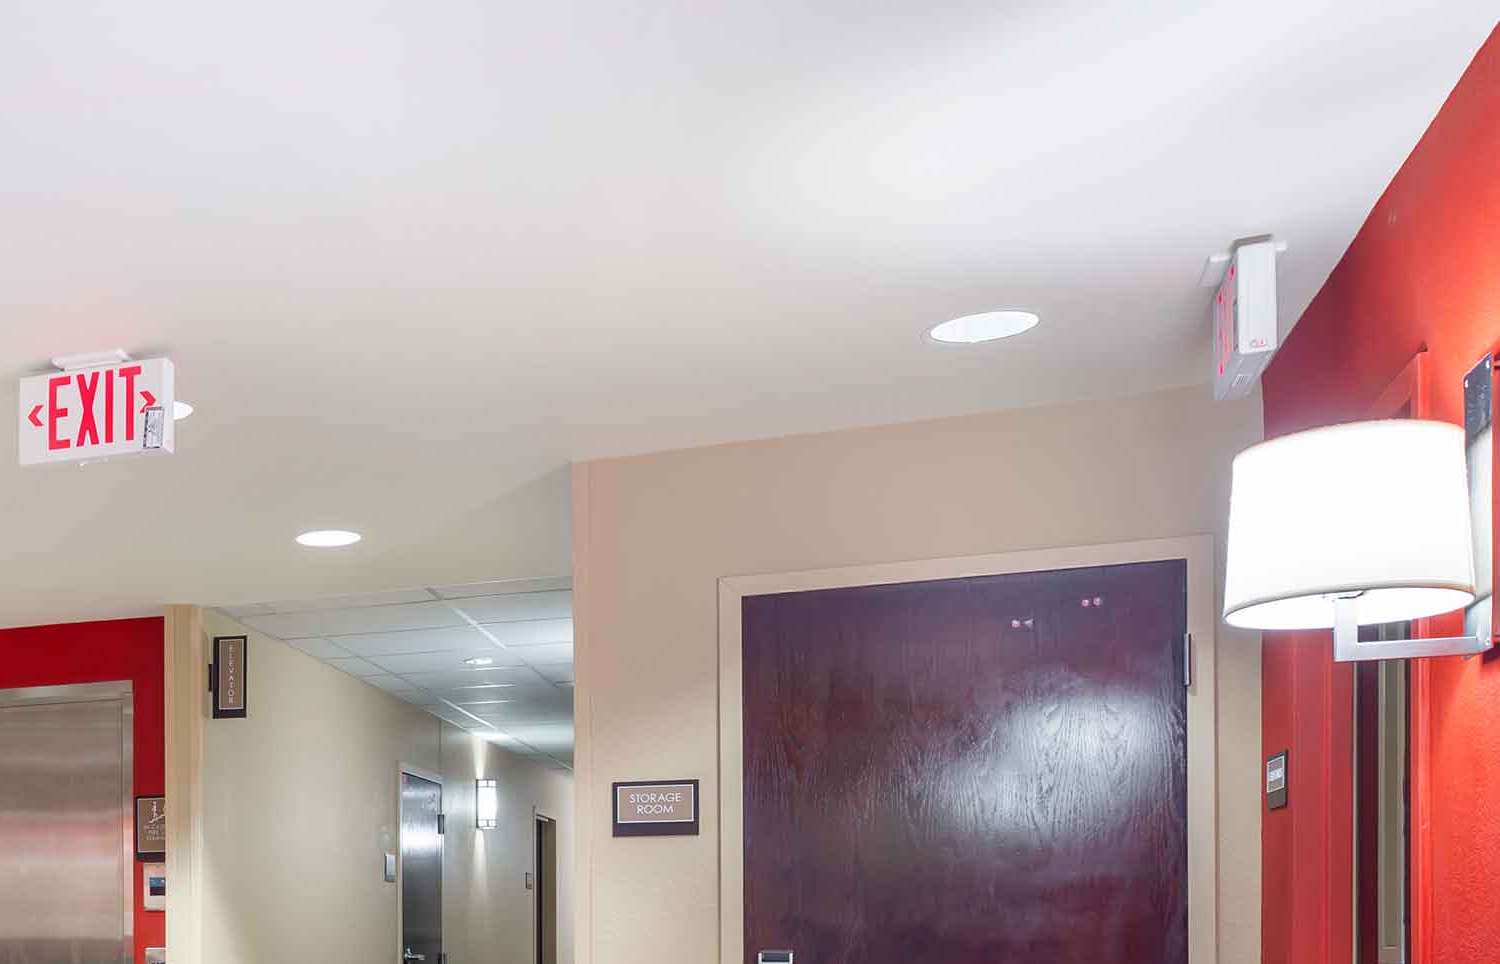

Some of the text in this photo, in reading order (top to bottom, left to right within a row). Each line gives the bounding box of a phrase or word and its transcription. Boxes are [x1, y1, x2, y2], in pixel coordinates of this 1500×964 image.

[48, 365, 142, 451] EXIT
[227, 643, 236, 704] ELEVATOR
[629, 793, 682, 803] STORAGE
[636, 804, 674, 814] ROOM
